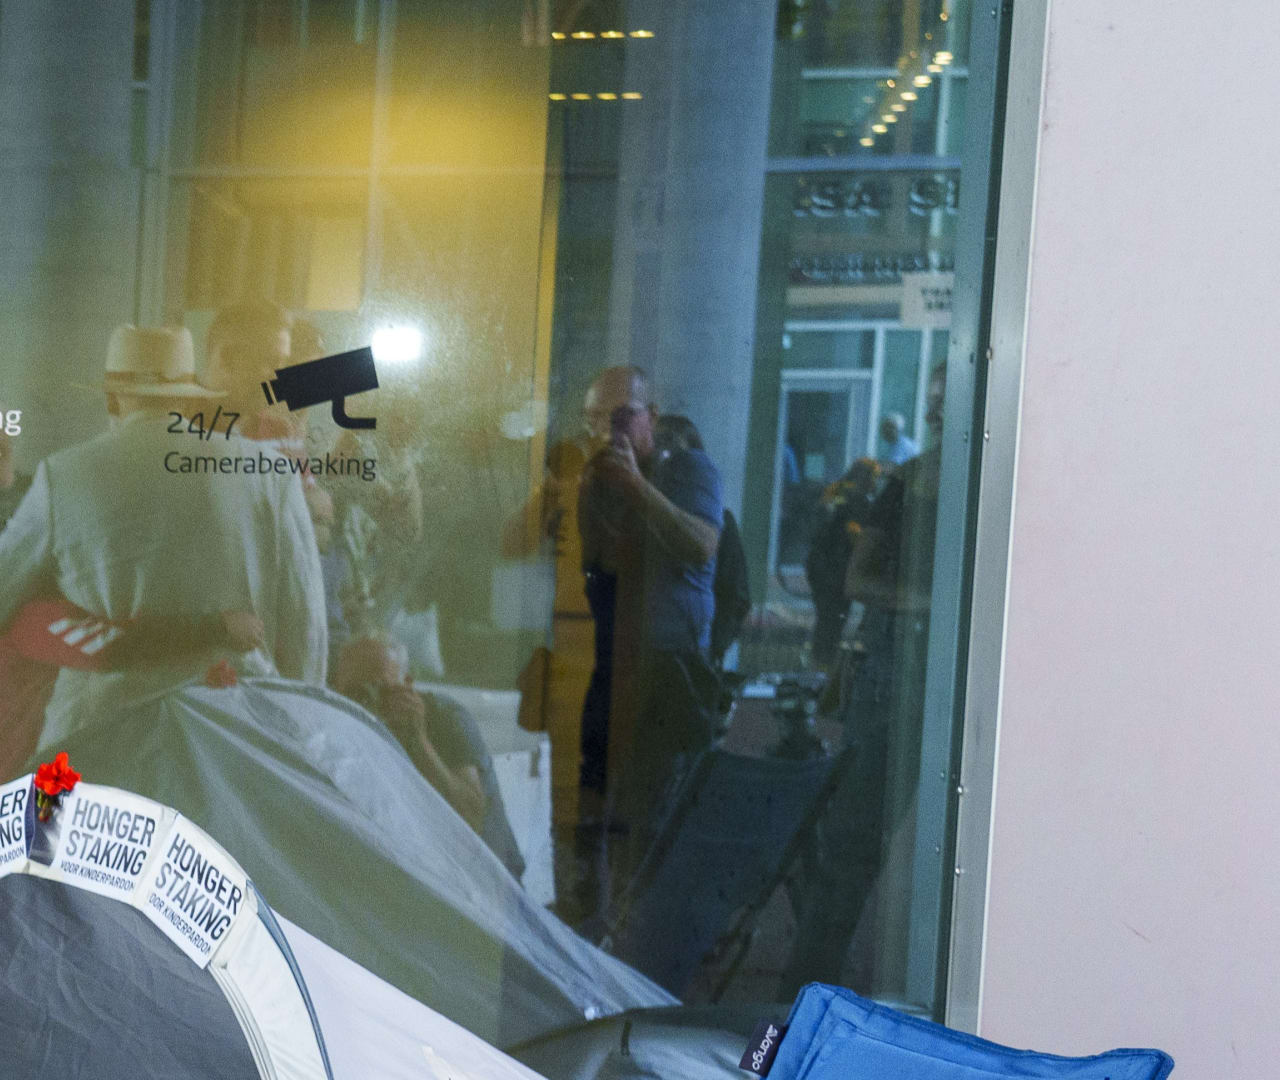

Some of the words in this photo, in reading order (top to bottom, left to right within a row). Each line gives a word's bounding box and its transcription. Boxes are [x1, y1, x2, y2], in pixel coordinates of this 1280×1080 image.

[167, 406, 240, 441] 24/7
[164, 452, 377, 482] Camerabewaking
[71, 797, 156, 848] HONGER
[60, 860, 80, 875] VOOR
[66, 830, 146, 876] STAKING
[167, 833, 242, 915] HONGER
[155, 863, 231, 940] STAKING
